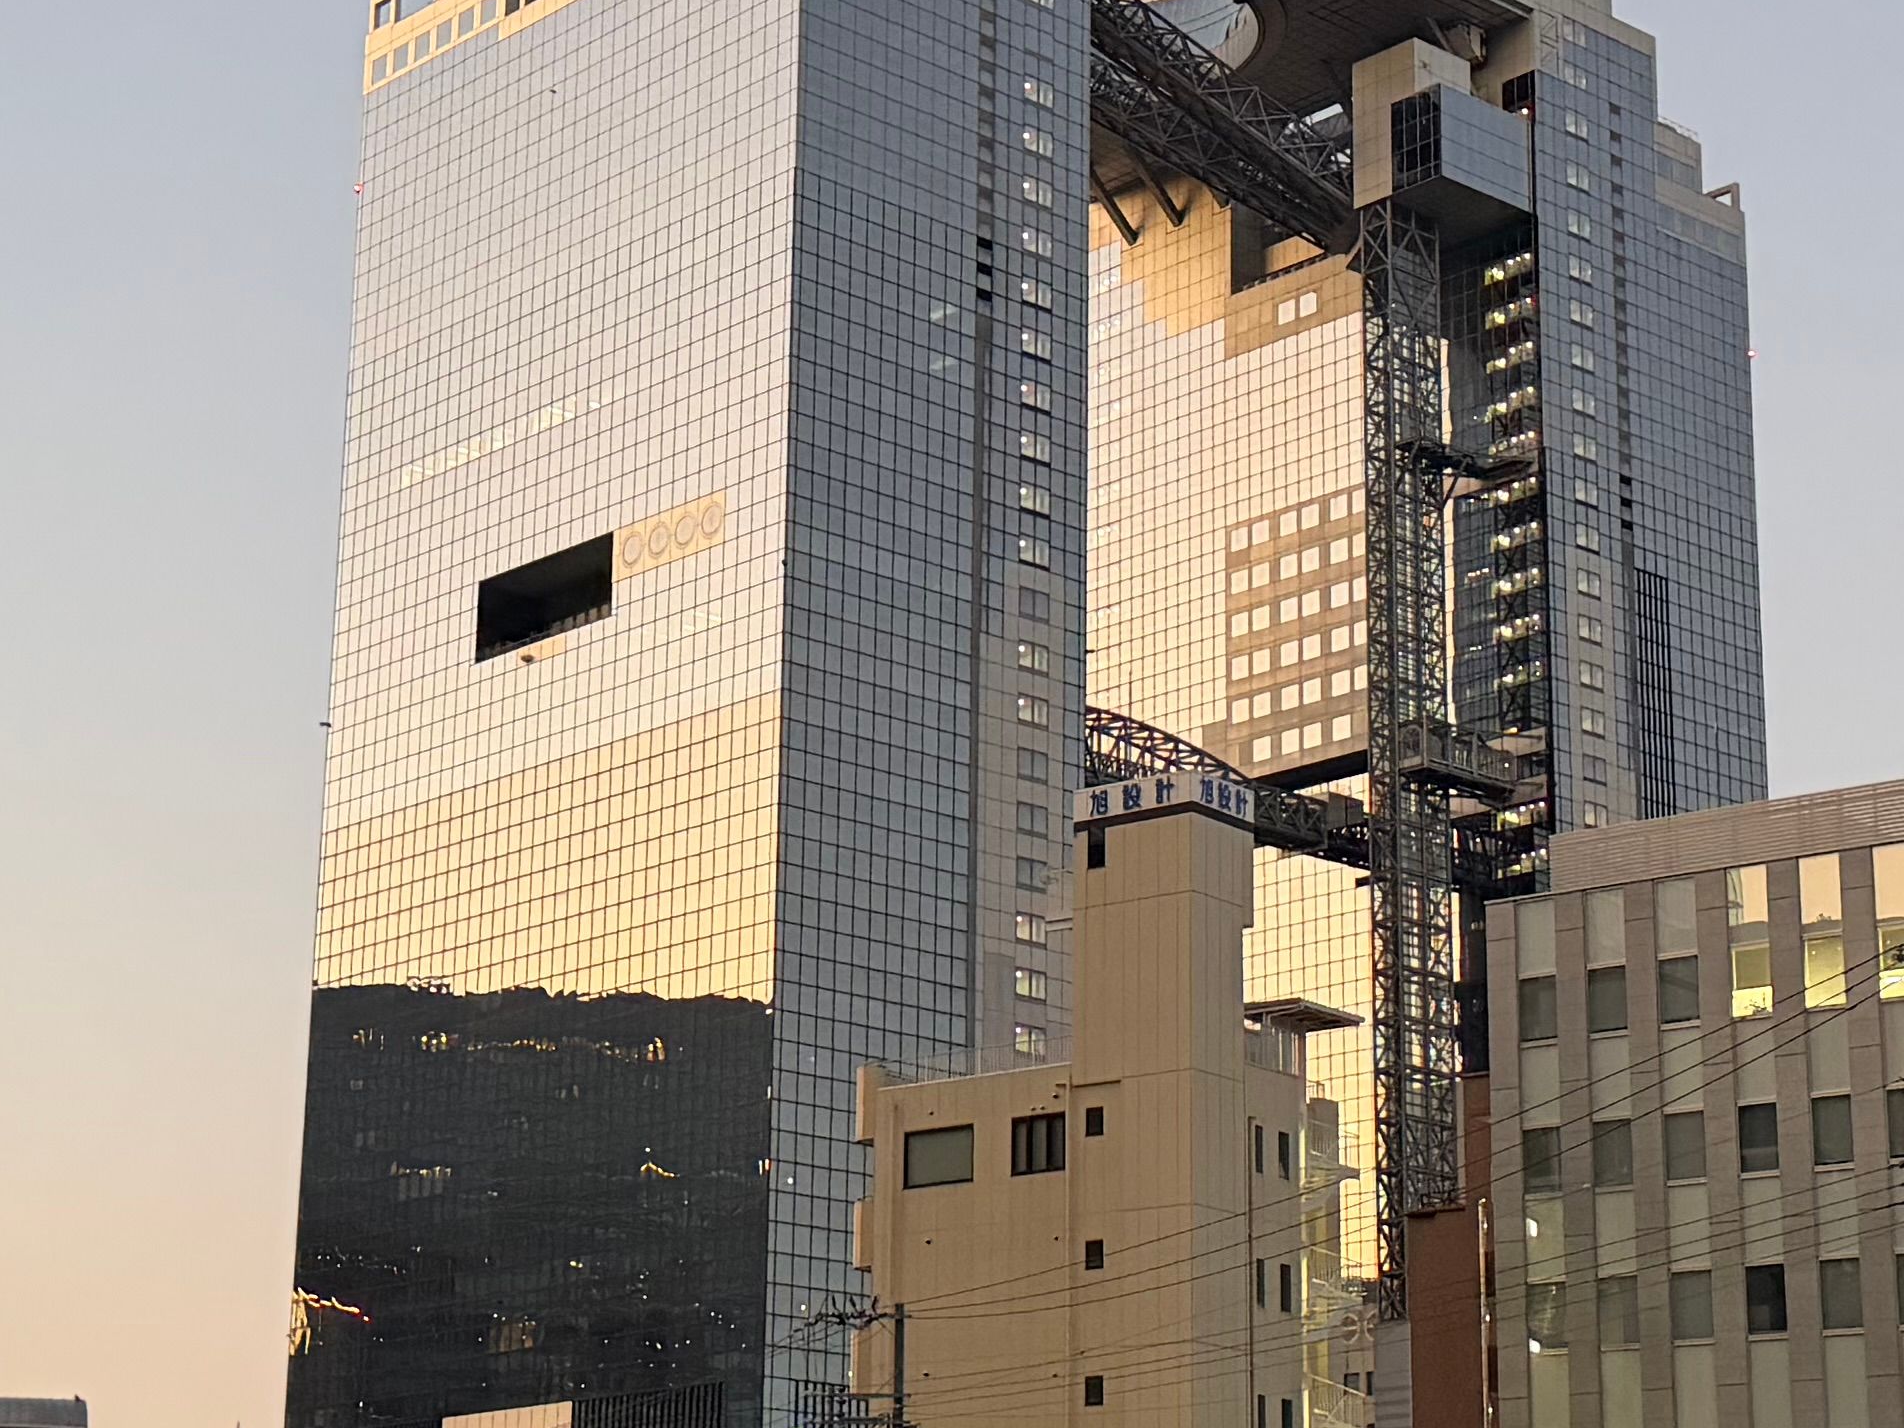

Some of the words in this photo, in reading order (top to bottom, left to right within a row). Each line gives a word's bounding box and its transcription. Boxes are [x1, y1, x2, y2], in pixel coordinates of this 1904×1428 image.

[1089, 776, 1176, 817] 旭設計
[1199, 776, 1248, 817] 旭設計
